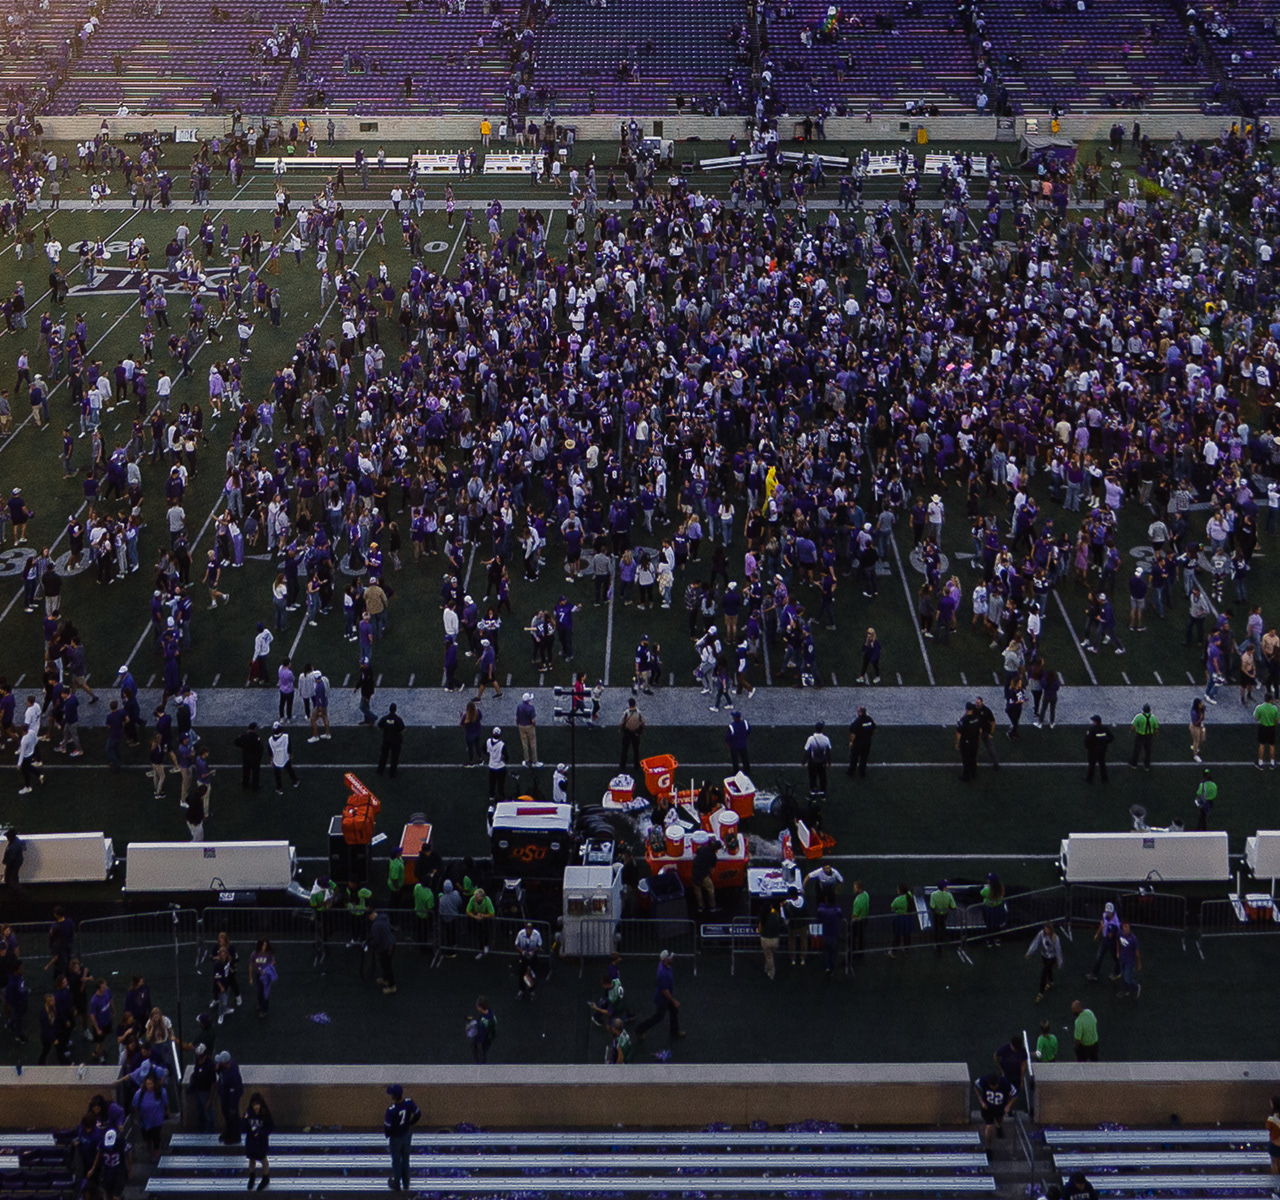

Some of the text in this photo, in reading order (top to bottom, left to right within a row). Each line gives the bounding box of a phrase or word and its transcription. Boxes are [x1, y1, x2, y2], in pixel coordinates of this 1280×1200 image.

[559, 612, 566, 622] 7
[658, 773, 671, 788] G
[513, 845, 547, 862] OSU
[985, 1090, 1004, 1106] 22
[399, 1109, 407, 1126] 7
[103, 1153, 121, 1167] 22
